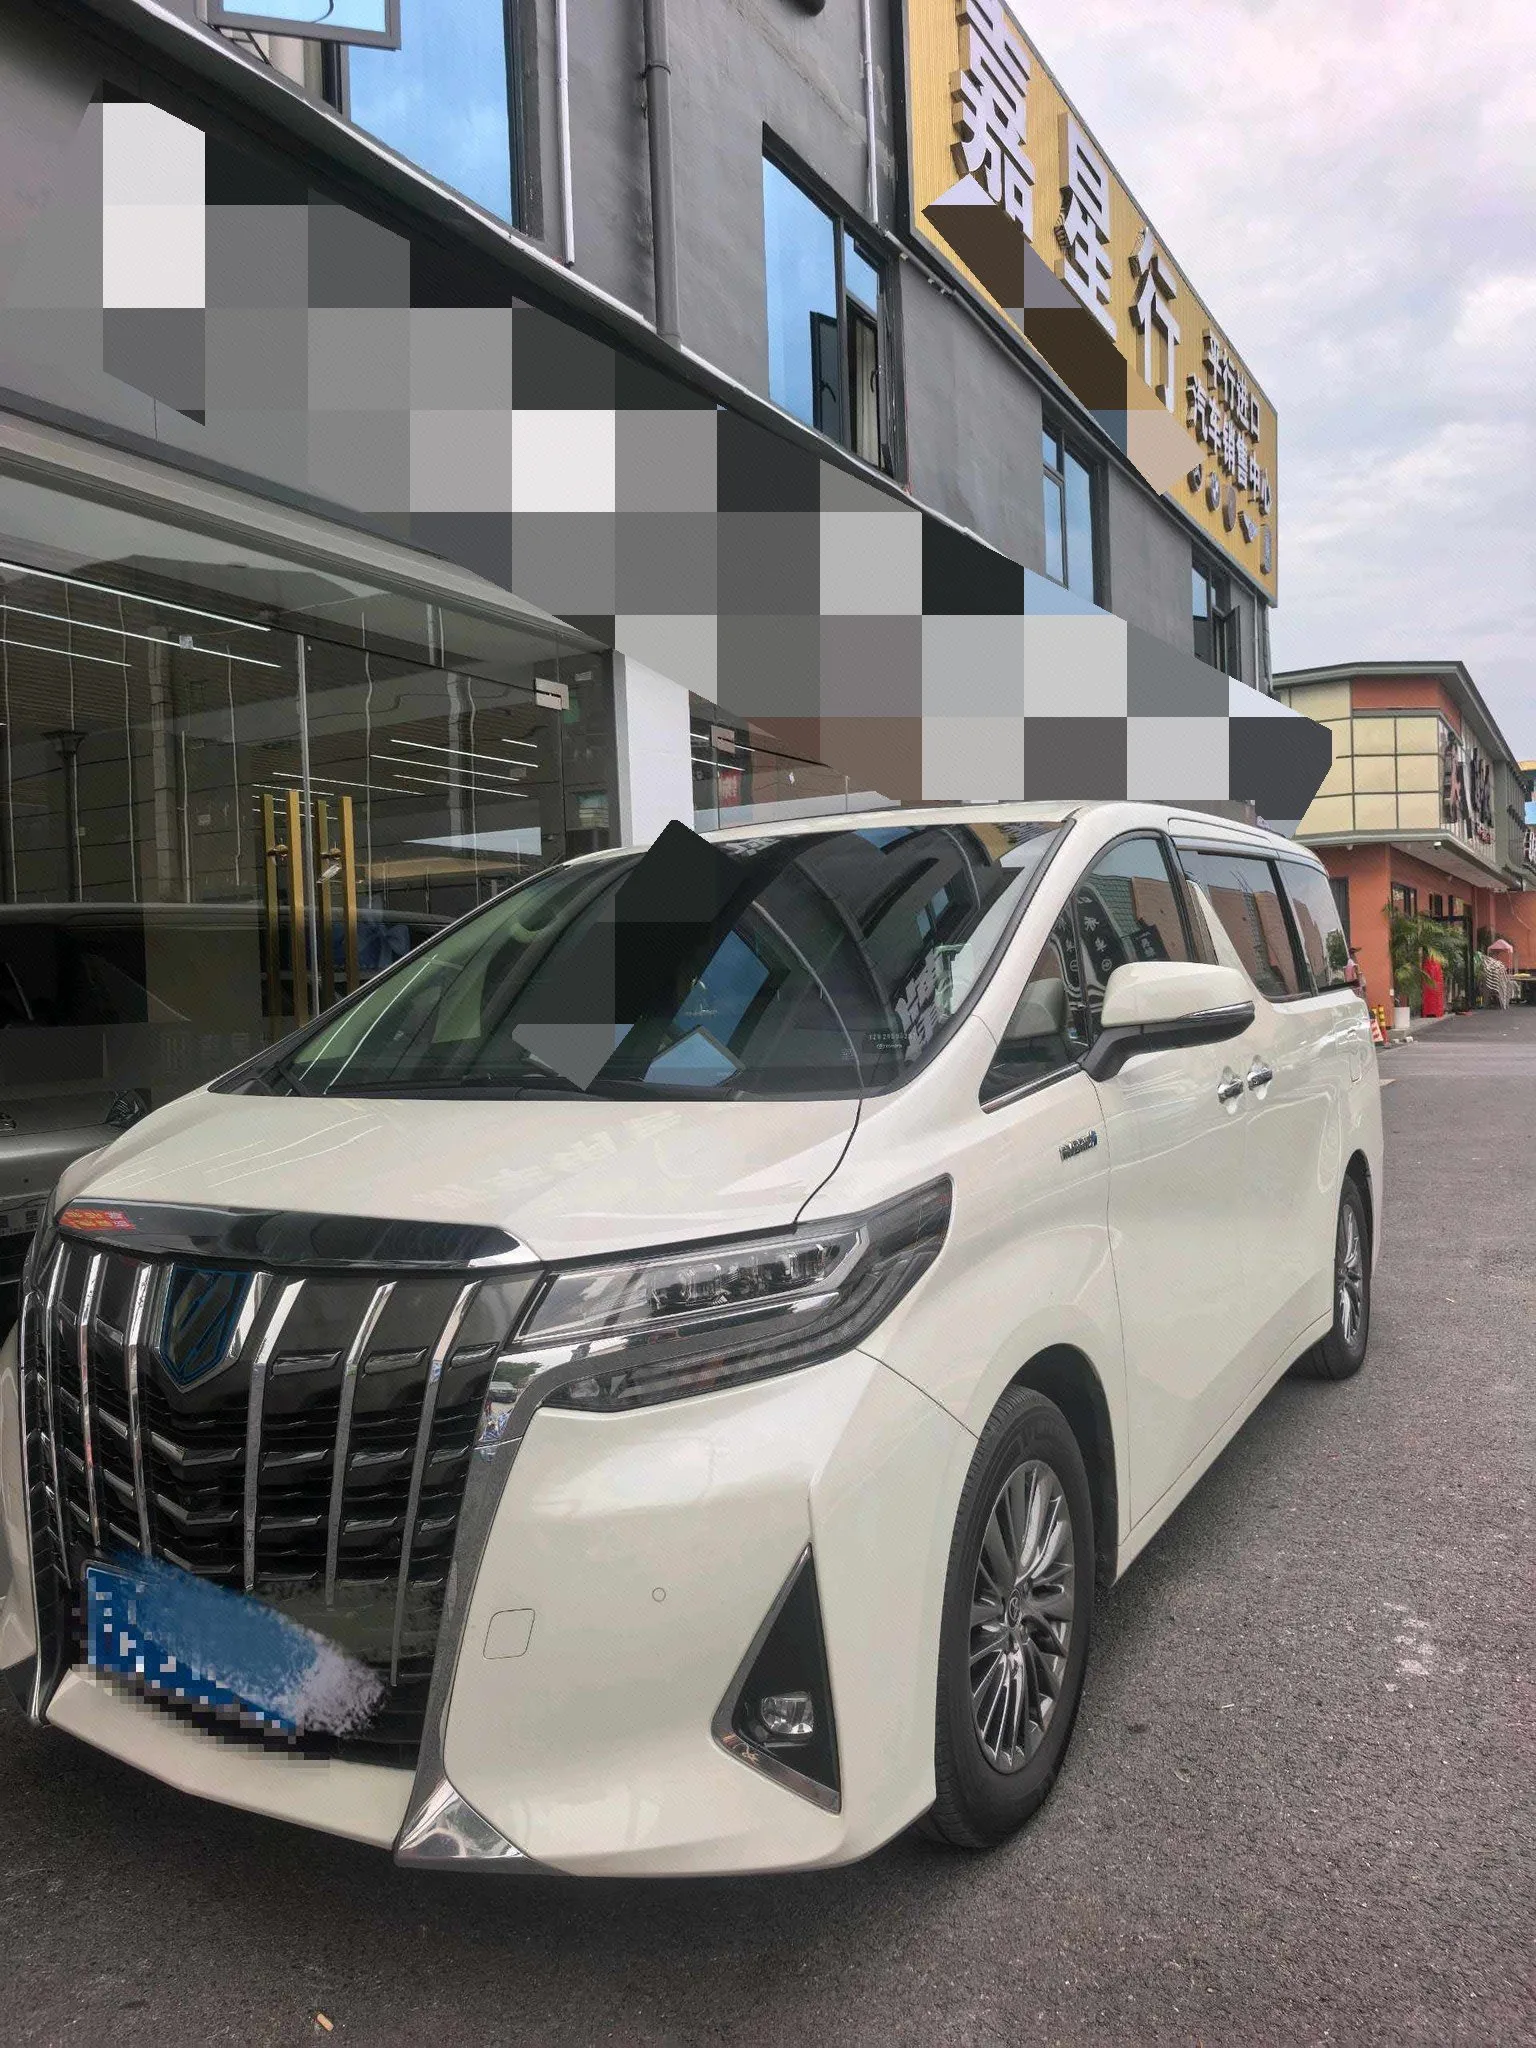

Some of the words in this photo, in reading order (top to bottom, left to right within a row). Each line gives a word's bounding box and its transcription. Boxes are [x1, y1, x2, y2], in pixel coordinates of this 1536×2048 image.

[951, 0, 1181, 414] 嘉星行
[1185, 372, 1272, 516] 汽车销售中心
[1202, 330, 1260, 443] 平行进口
